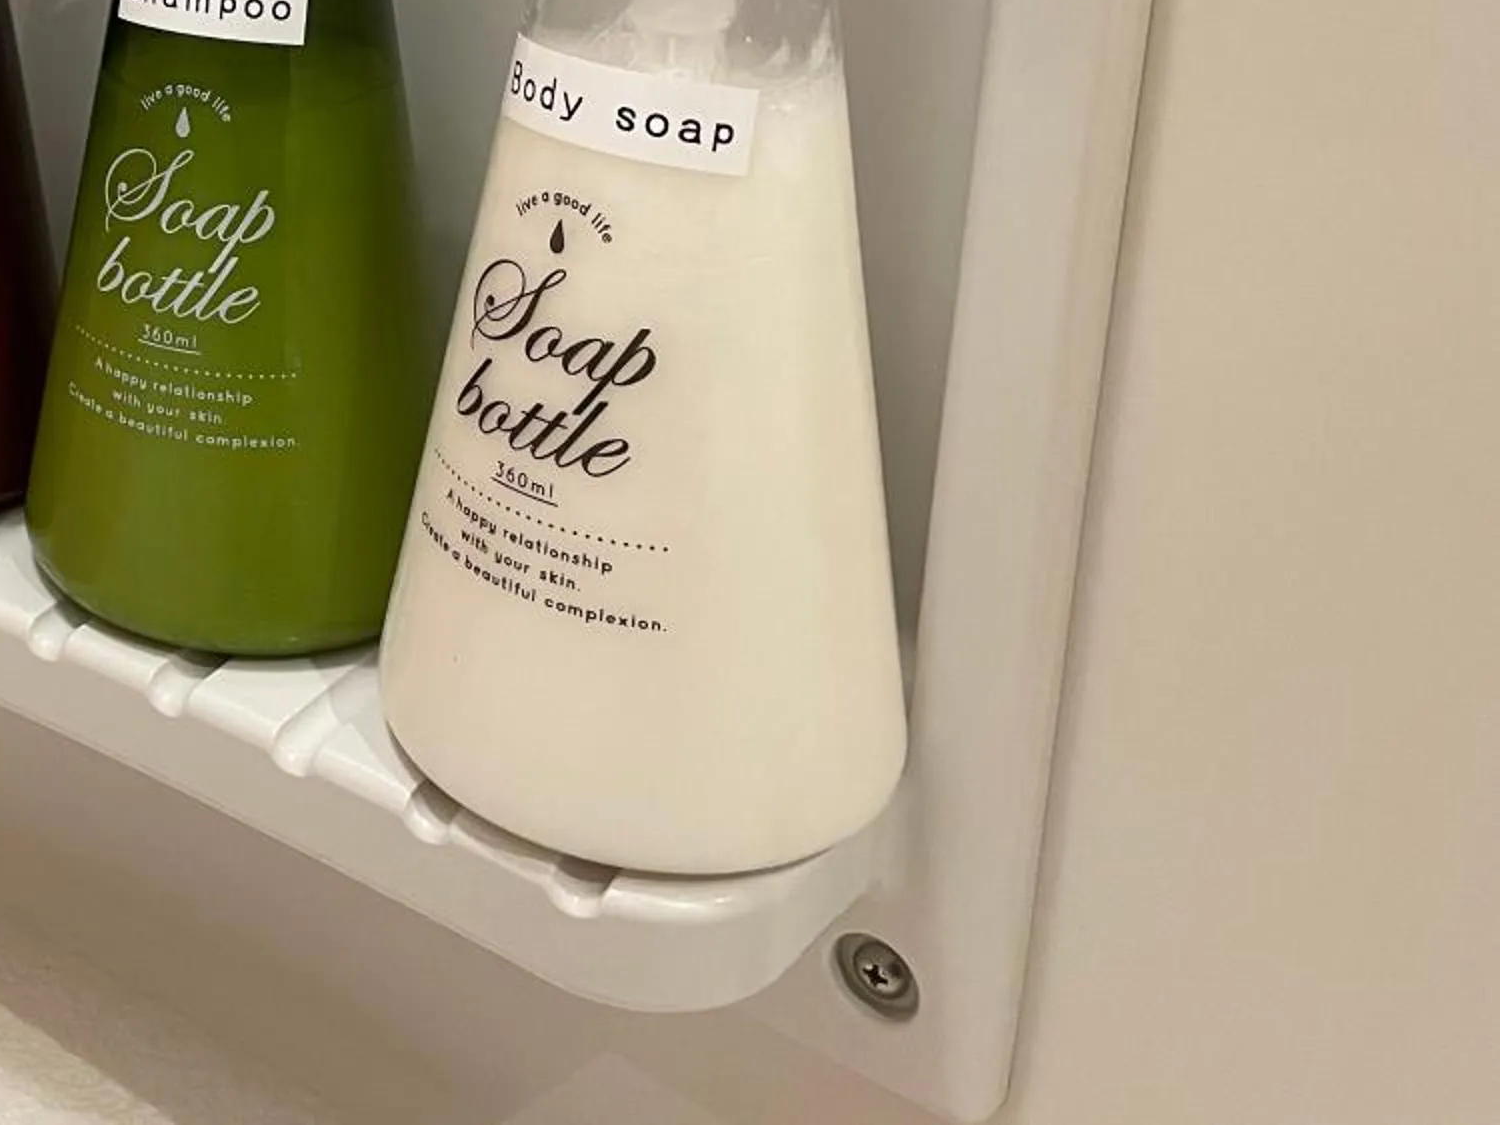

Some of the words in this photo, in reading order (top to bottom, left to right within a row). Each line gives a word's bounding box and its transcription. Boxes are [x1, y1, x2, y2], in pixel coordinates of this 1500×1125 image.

[140, 89, 163, 111] live
[163, 84, 173, 95] a
[175, 84, 211, 102] good
[211, 96, 231, 123] life
[511, 60, 584, 121] Body
[615, 106, 735, 152] soap
[104, 148, 275, 274] Soap
[515, 194, 538, 217] live
[541, 190, 550, 203] a
[553, 192, 592, 217] good
[591, 212, 613, 244] life
[97, 236, 260, 324] bottle
[142, 323, 197, 349] 360ml
[470, 259, 656, 416] Soap
[104, 360, 148, 391] happy
[152, 380, 254, 407] relationship
[112, 388, 141, 408] with
[146, 402, 181, 417] your
[105, 410, 115, 420] a
[118, 411, 190, 442] beautiful
[456, 357, 631, 478] bottle
[495, 460, 555, 498] 360ml
[446, 488, 455, 504] A
[455, 495, 498, 535] happy
[503, 528, 614, 576] relationship
[460, 529, 489, 554] with
[494, 550, 531, 575] your
[539, 567, 582, 592] skin.
[451, 550, 461, 561] a
[464, 554, 537, 603] beautiful
[544, 596, 668, 633] complexion.
